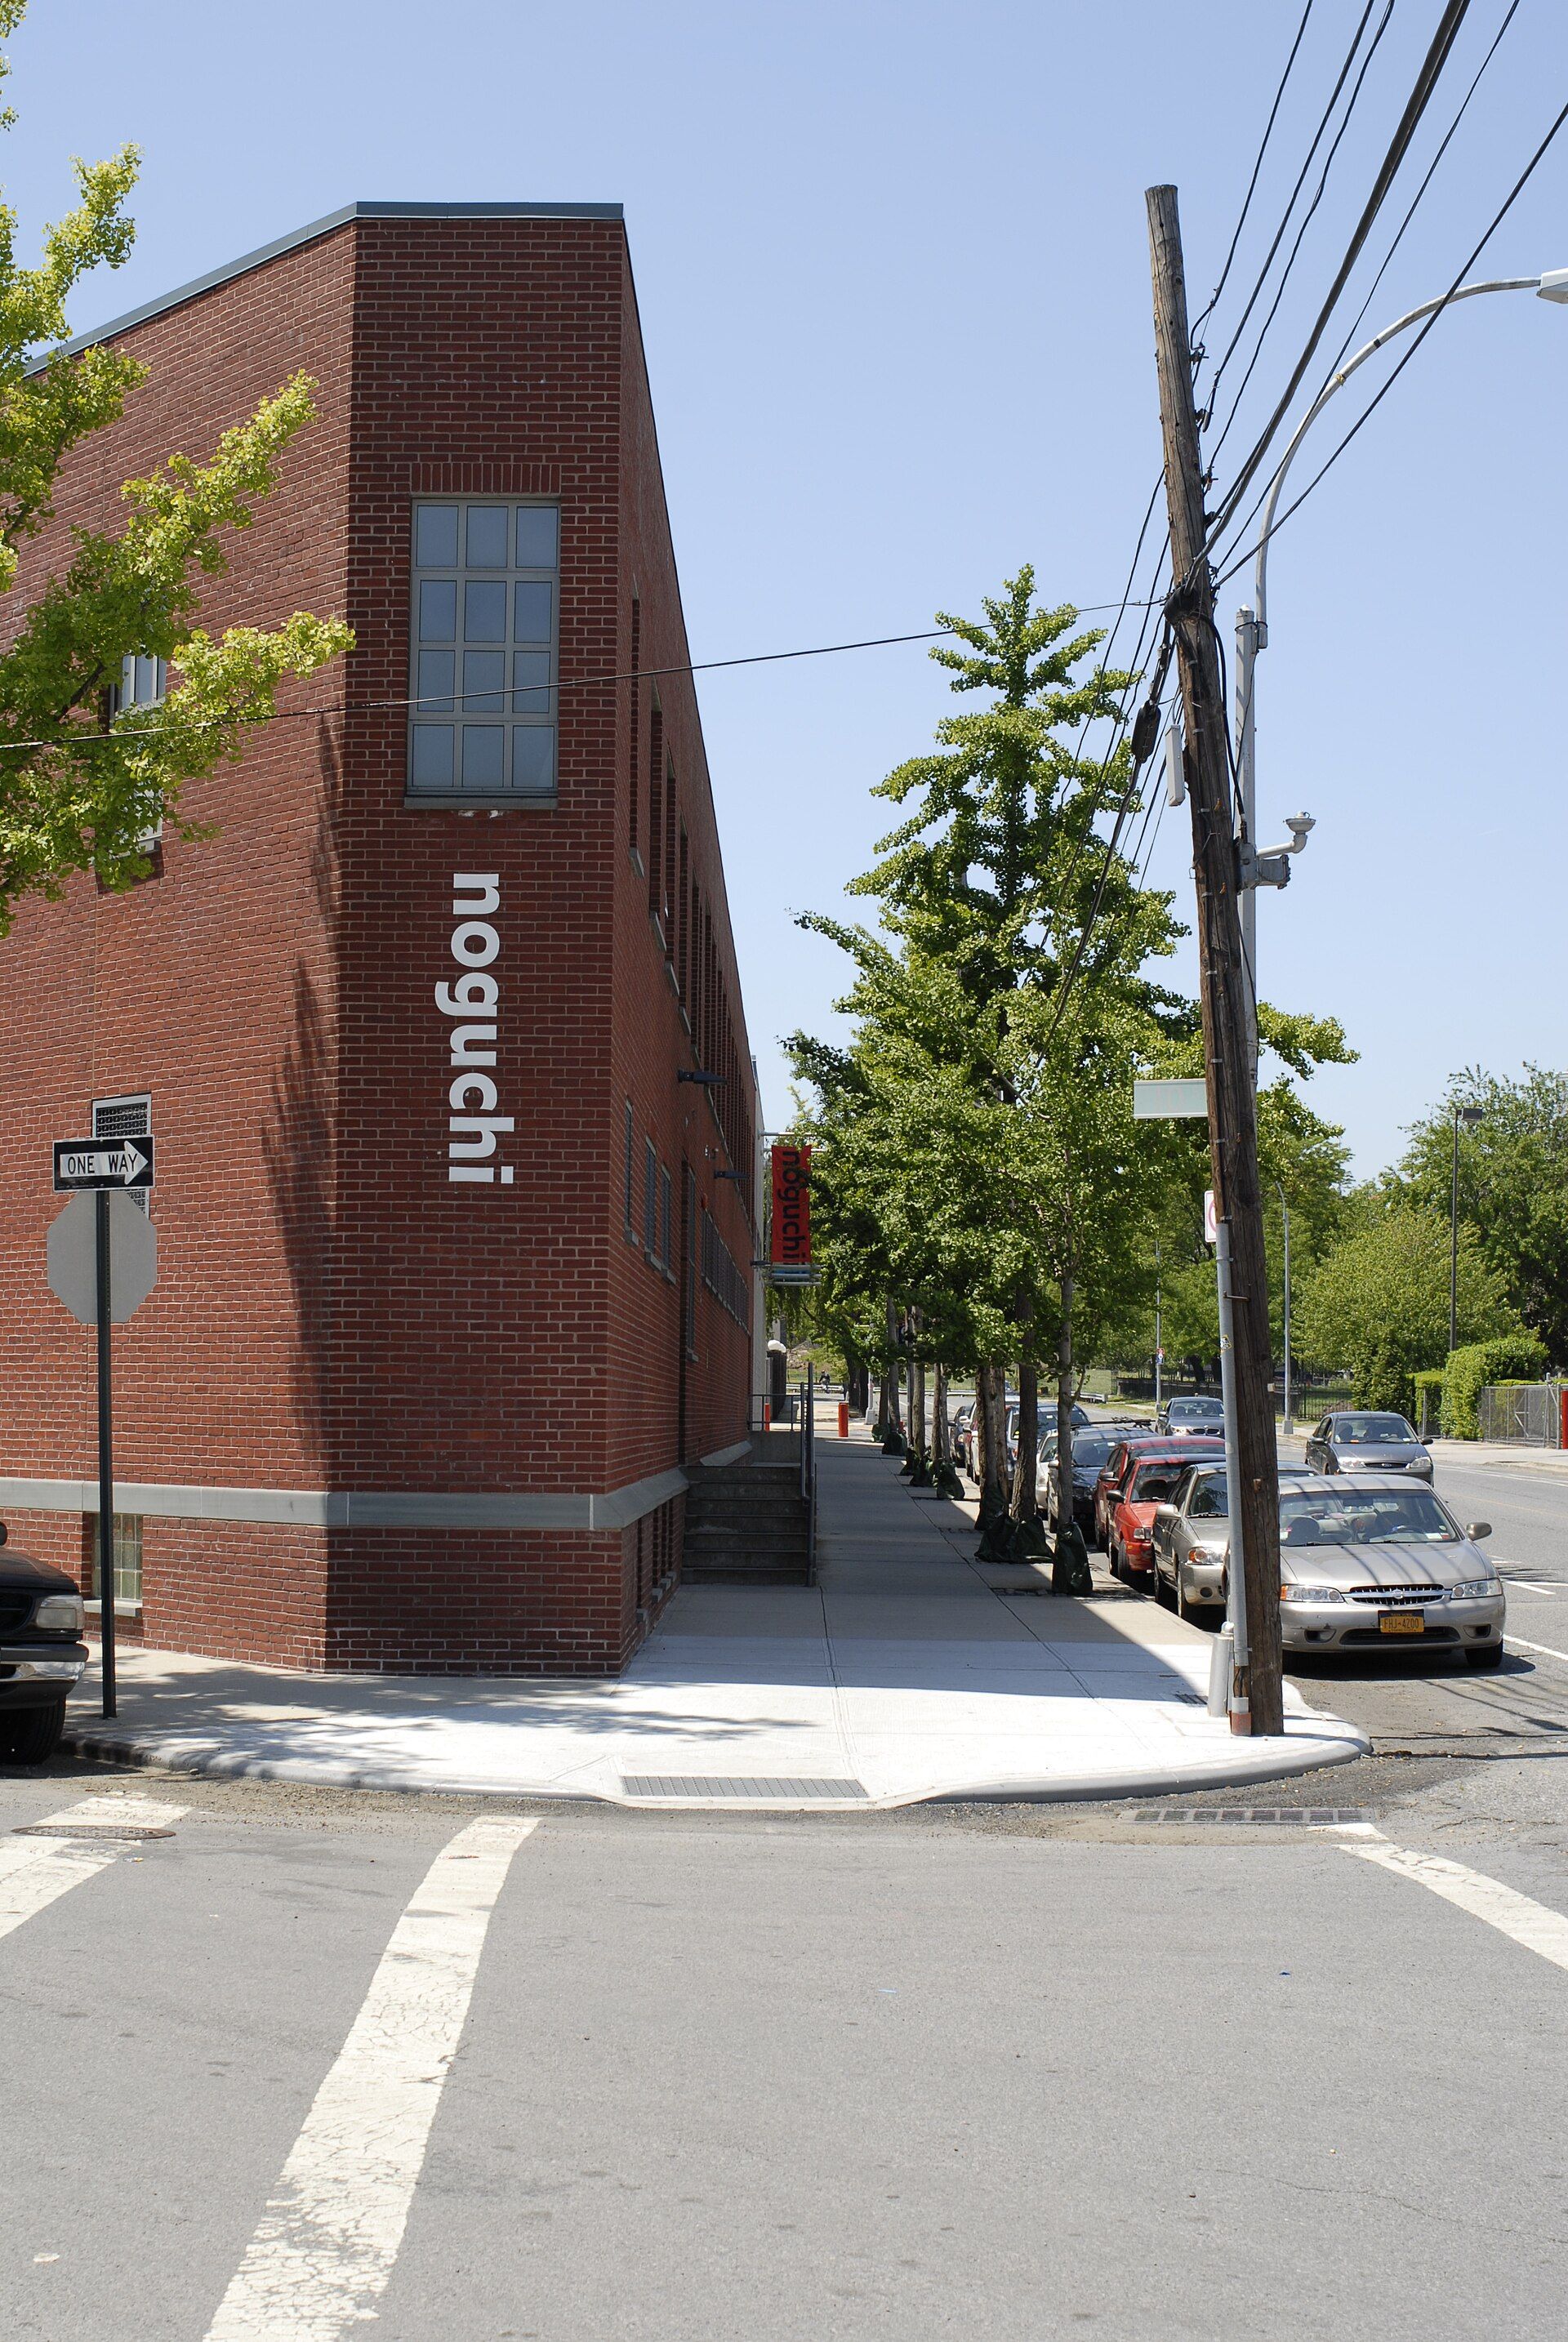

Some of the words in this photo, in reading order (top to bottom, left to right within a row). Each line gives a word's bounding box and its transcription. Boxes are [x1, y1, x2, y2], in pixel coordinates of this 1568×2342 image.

[434, 873, 514, 1184] noguchi
[68, 1155, 96, 1175] ONE
[108, 1153, 138, 1173] WAY
[777, 1151, 806, 1259] noguchi
